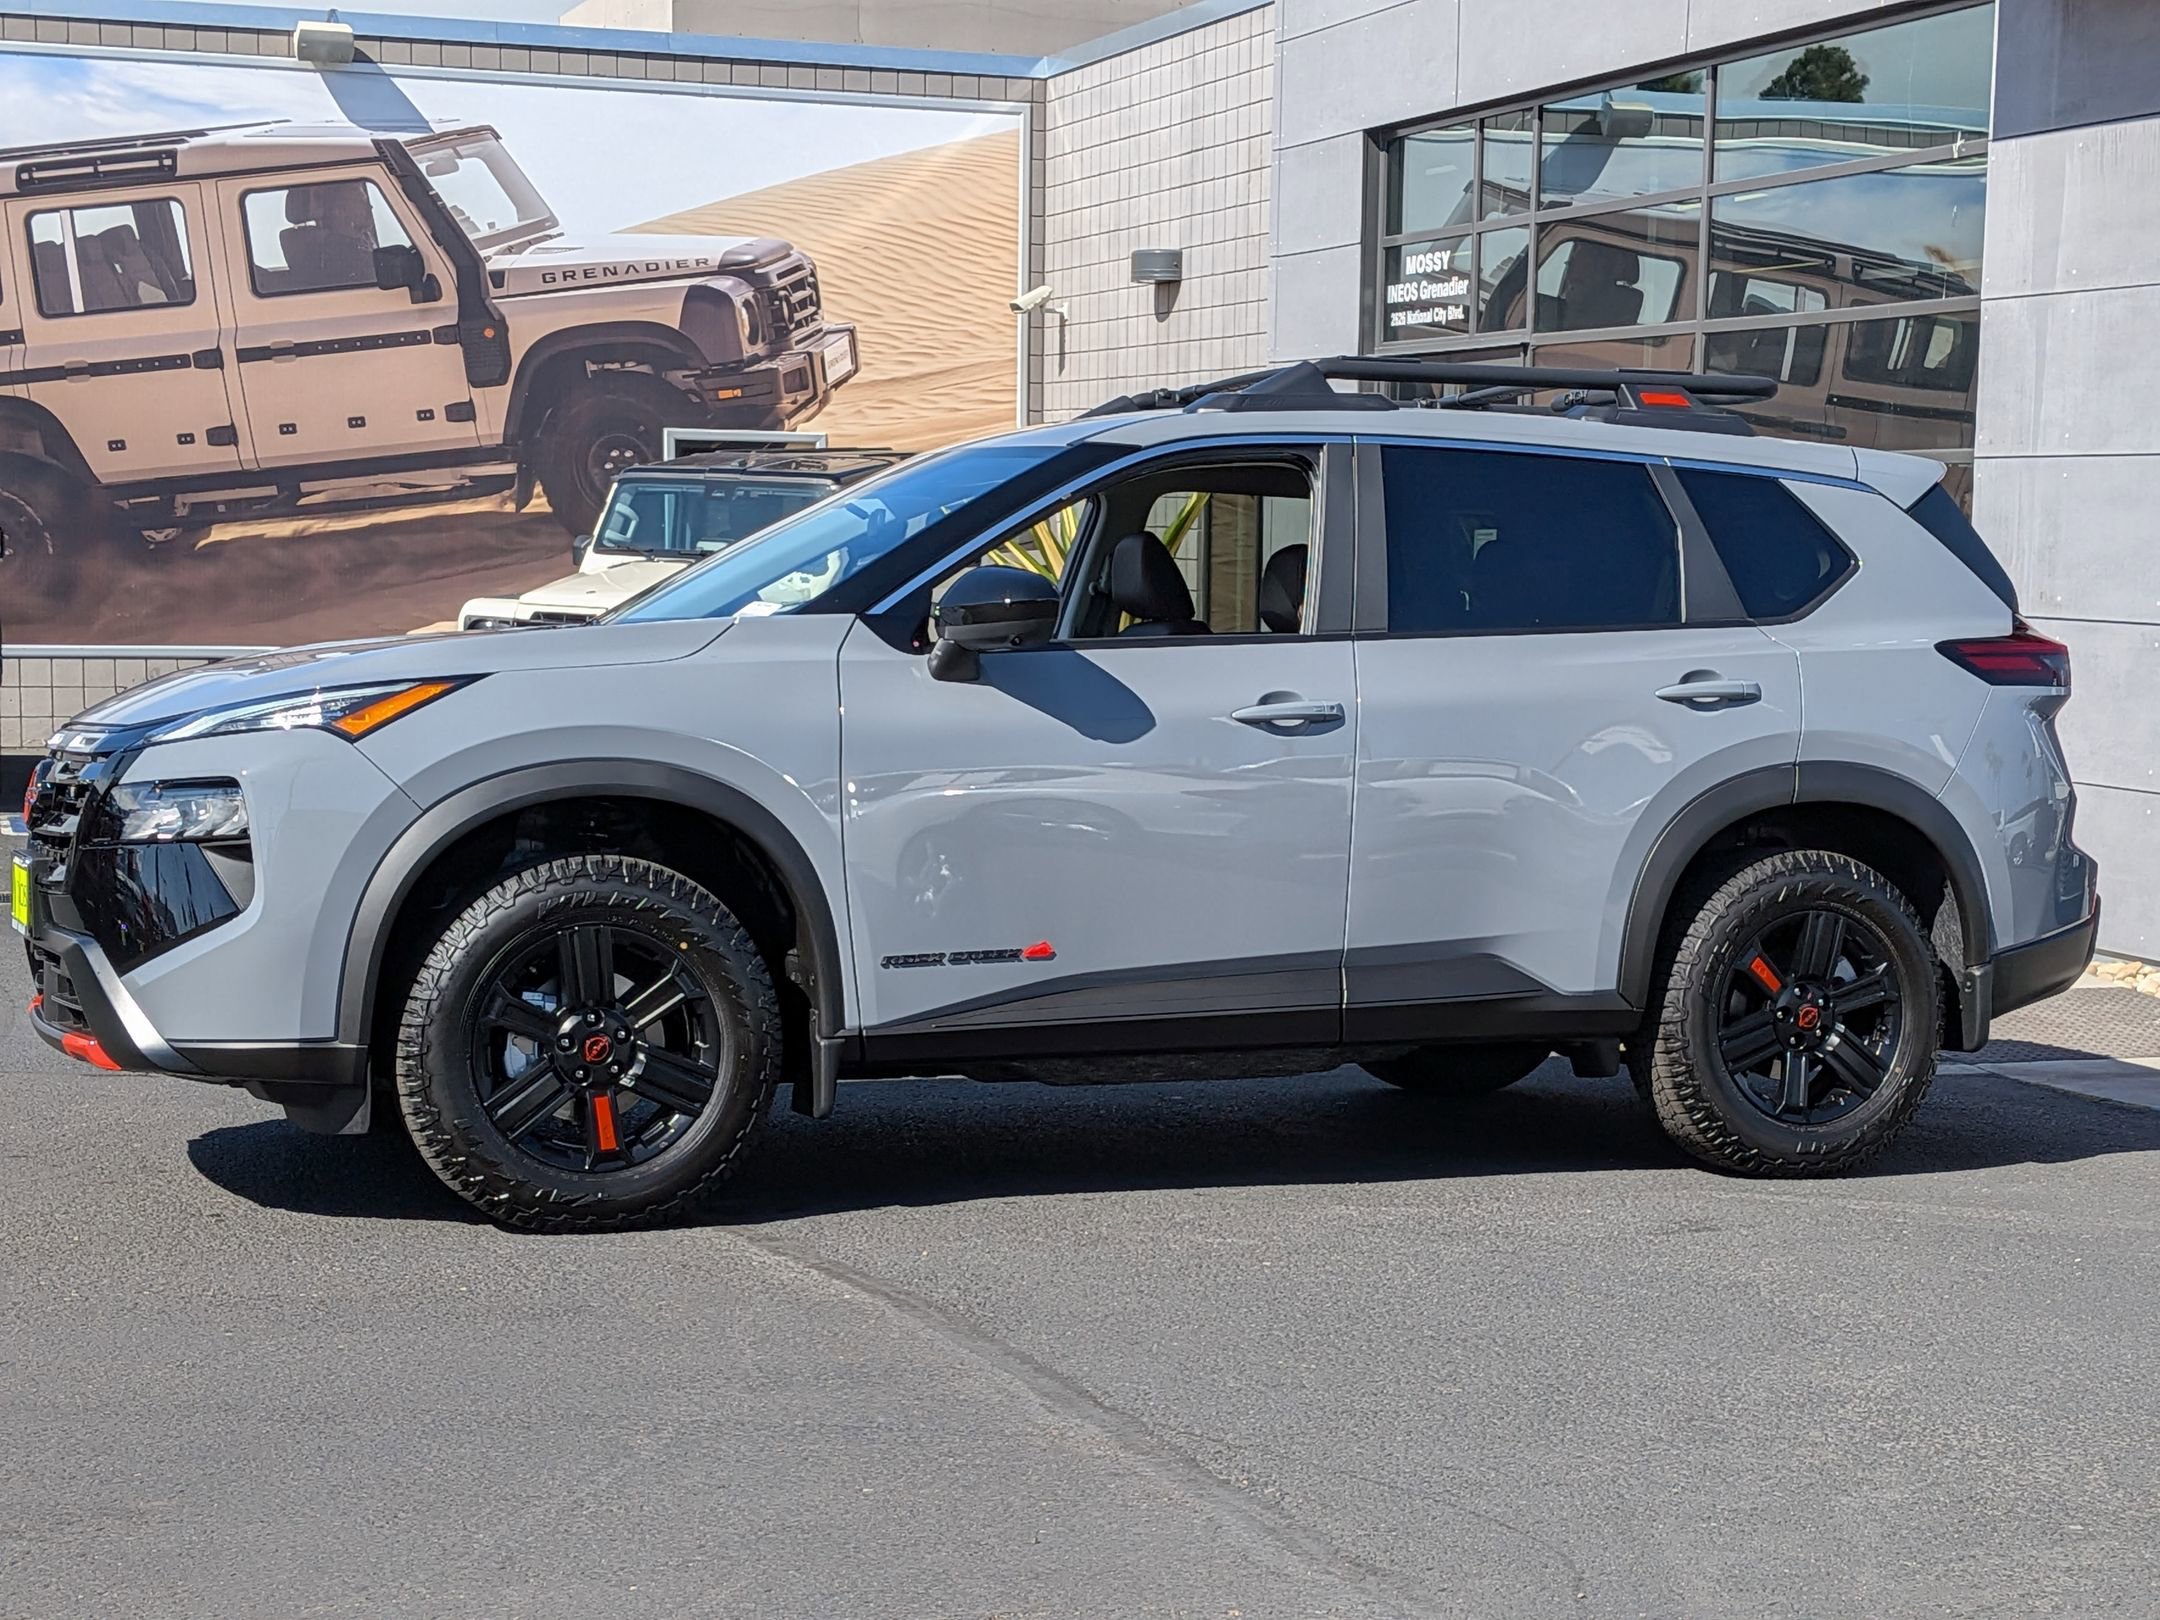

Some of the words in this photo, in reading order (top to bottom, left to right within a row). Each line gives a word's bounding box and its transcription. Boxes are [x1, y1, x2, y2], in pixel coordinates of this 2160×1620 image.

[541, 258, 710, 284] GRENADIER
[1405, 250, 1451, 275] MOSSY
[1387, 281, 1418, 304] INEOS
[1420, 276, 1469, 300] Grenadier
[1406, 308, 1433, 325] National
[1433, 307, 1447, 325] City
[880, 953, 947, 969] ROCK
[947, 949, 1024, 965] CREEK
